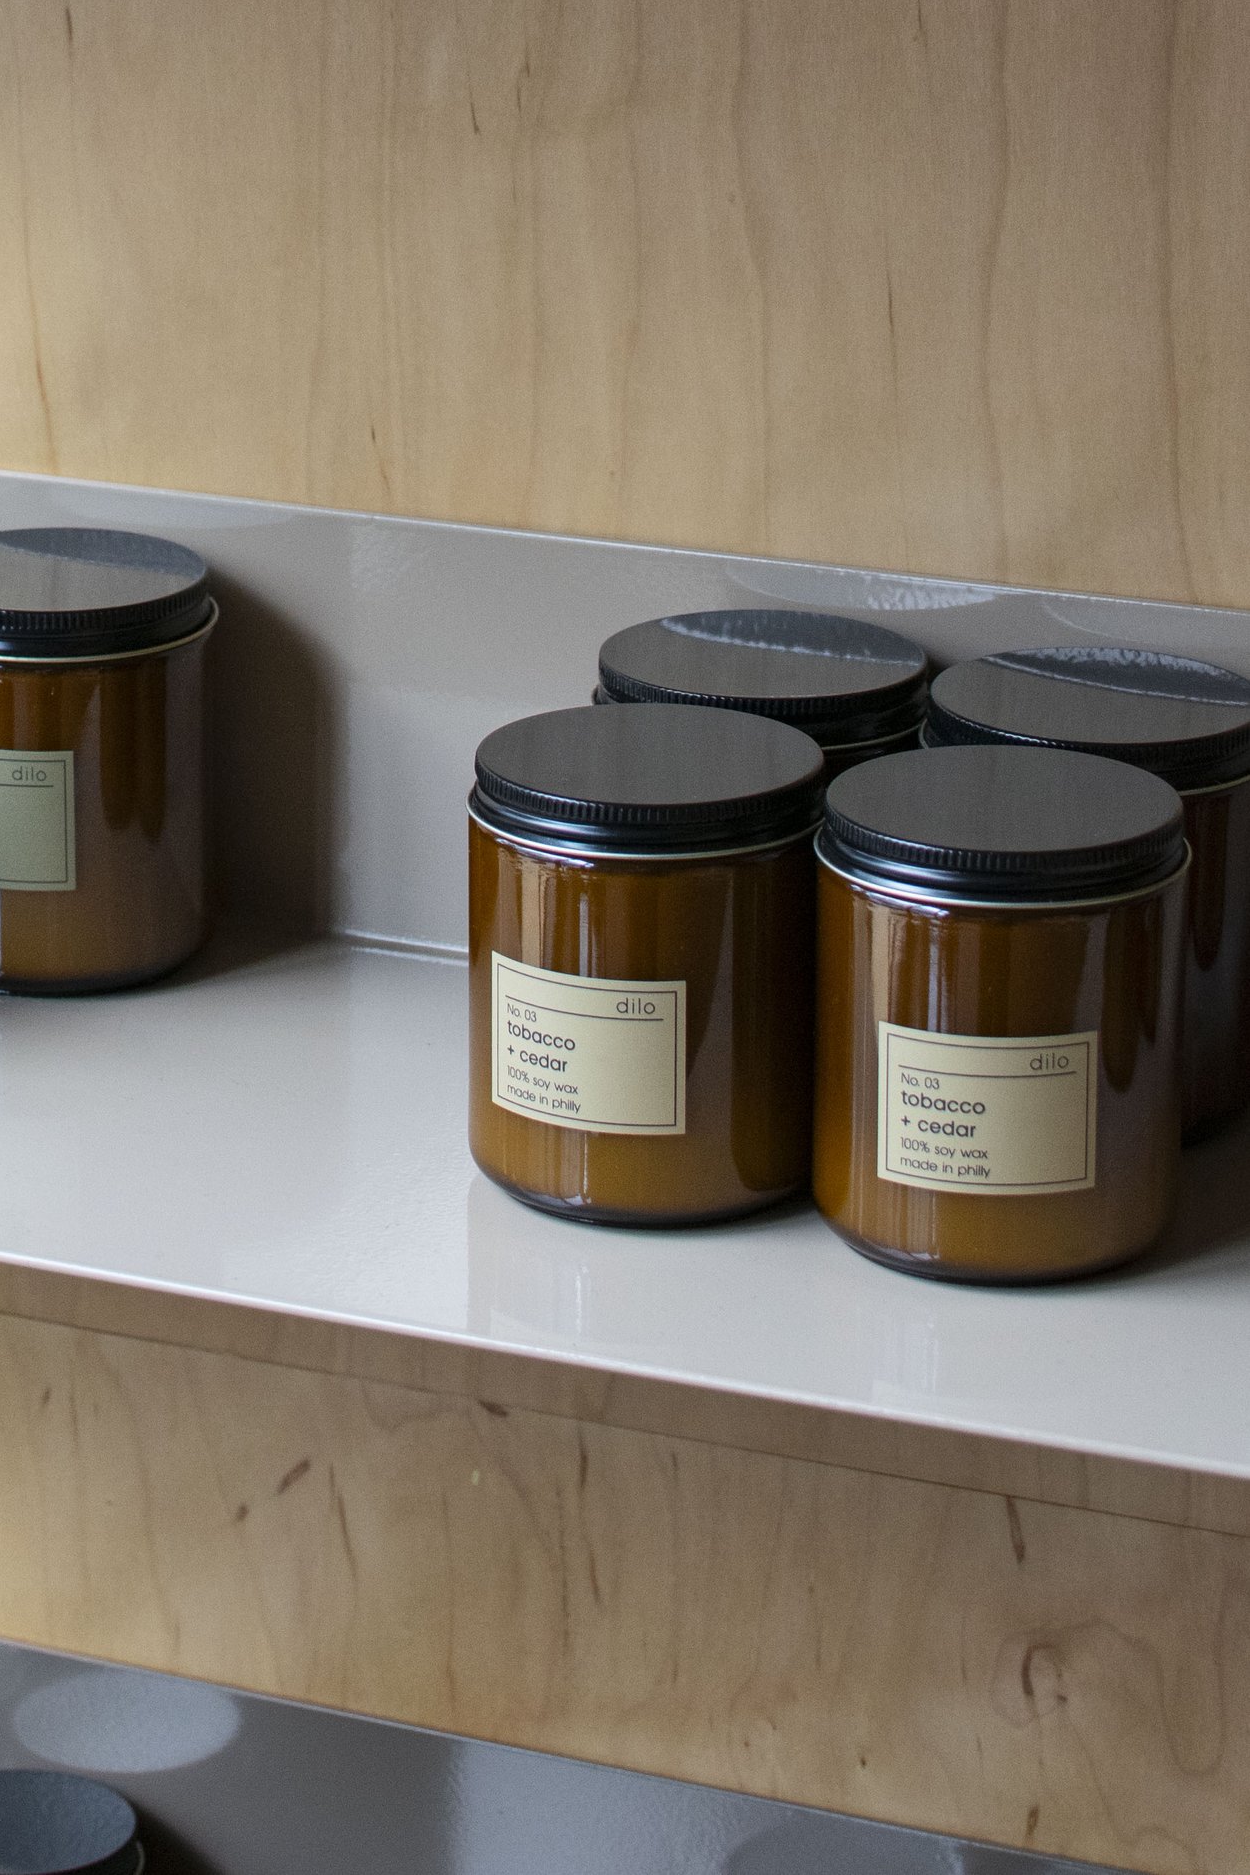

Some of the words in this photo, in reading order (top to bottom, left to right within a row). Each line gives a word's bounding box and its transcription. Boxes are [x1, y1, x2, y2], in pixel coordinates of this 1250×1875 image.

[12, 766, 47, 781] dilo
[507, 1003, 521, 1018] No.
[525, 1008, 537, 1022] 03
[616, 998, 655, 1015] dilo
[507, 1020, 576, 1051] tobacco
[507, 1044, 514, 1055] +
[520, 1049, 568, 1072] cedar
[1030, 1053, 1069, 1070] dilo
[507, 1064, 529, 1083] 100%
[533, 1076, 550, 1091] soy
[554, 1082, 578, 1095] wax
[901, 1073, 920, 1087] No.
[924, 1076, 940, 1090] 03
[507, 1083, 536, 1102] made
[539, 1092, 548, 1105] in
[552, 1095, 581, 1114] philly
[901, 1090, 986, 1115] tobacco
[901, 1115, 910, 1126] +
[918, 1118, 976, 1138] cedar
[900, 1137, 930, 1153] 100%
[934, 1144, 955, 1159] soy
[961, 1147, 988, 1160] wax
[900, 1156, 937, 1172] made
[942, 1162, 953, 1174] in
[958, 1163, 990, 1178] philly
